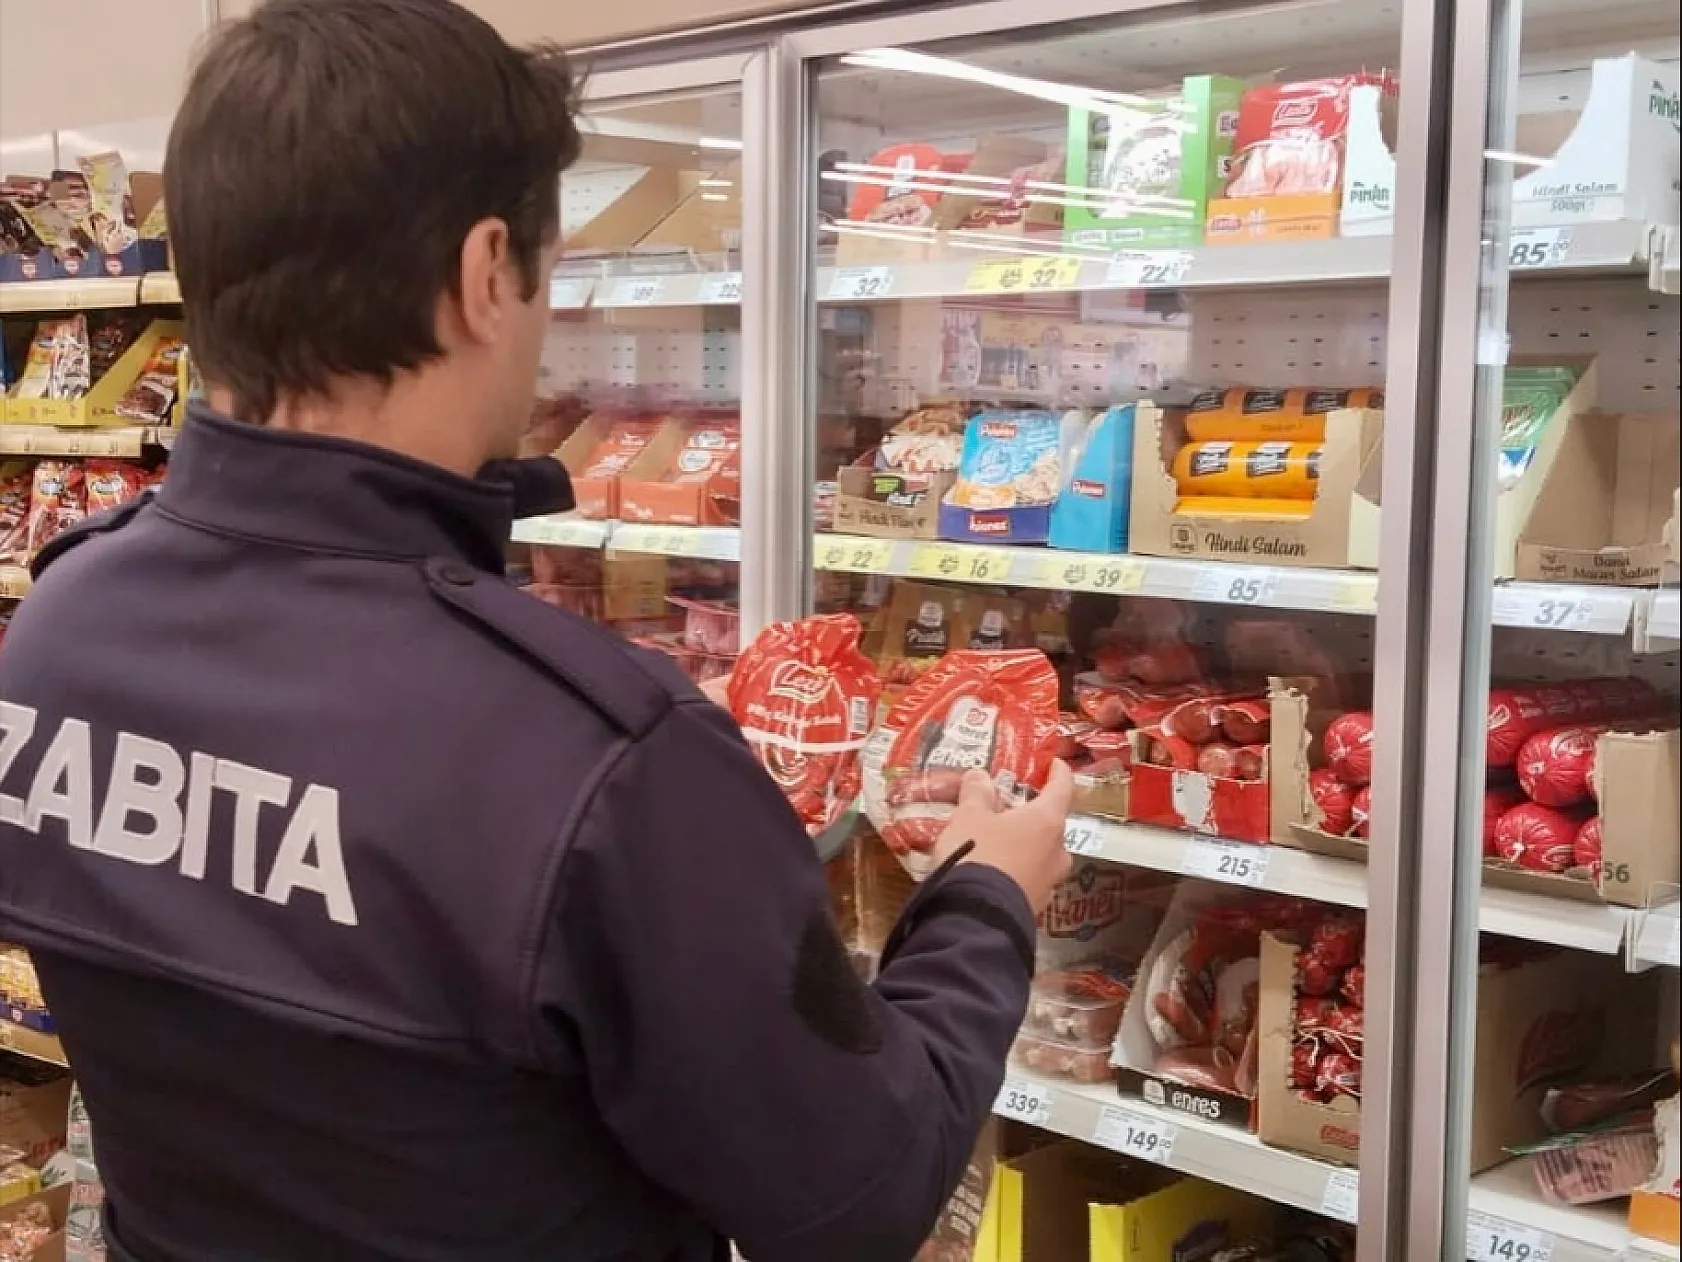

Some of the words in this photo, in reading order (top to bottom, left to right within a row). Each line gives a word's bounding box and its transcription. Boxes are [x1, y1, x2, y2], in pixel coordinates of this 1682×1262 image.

[1204, 532, 1249, 553] Hindi
[1252, 536, 1308, 557] Salam
[851, 551, 874, 567] 22
[969, 559, 990, 578] 16
[1092, 568, 1122, 589] 39
[1228, 577, 1262, 601] 85
[1534, 600, 1576, 625] 37
[0, 701, 358, 926] ZABITA
[1064, 827, 1091, 850] 47
[1217, 854, 1251, 877] 215
[1005, 1091, 1039, 1114] 339
[1125, 1127, 1158, 1151] 149
[1488, 1234, 1530, 1262] 149
